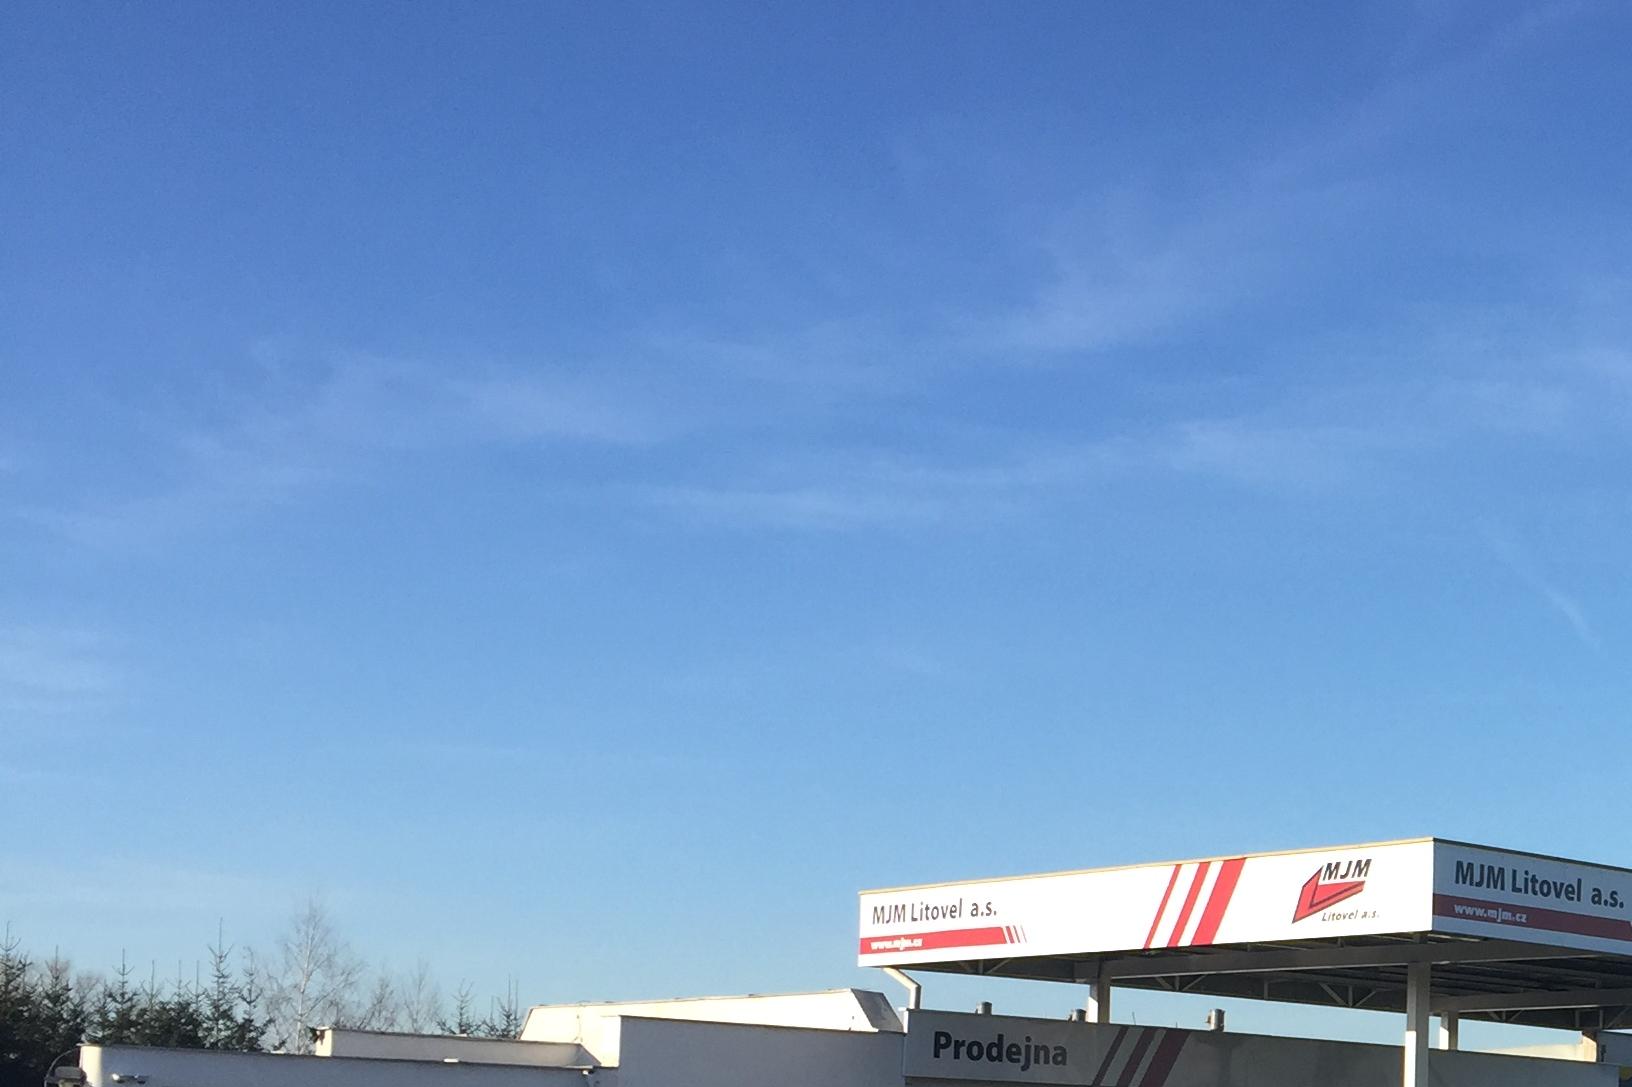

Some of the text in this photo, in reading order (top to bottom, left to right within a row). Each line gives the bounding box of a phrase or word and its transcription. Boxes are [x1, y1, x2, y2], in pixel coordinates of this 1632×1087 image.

[1323, 859, 1372, 881] MJM
[1454, 860, 1624, 908] MJM Litovel a.s.
[873, 898, 997, 925] MJM Litovel a.s.
[1321, 909, 1359, 922] Litovel
[1454, 904, 1527, 923] www.mjm.cz
[933, 1031, 1067, 1072] Prodejna
